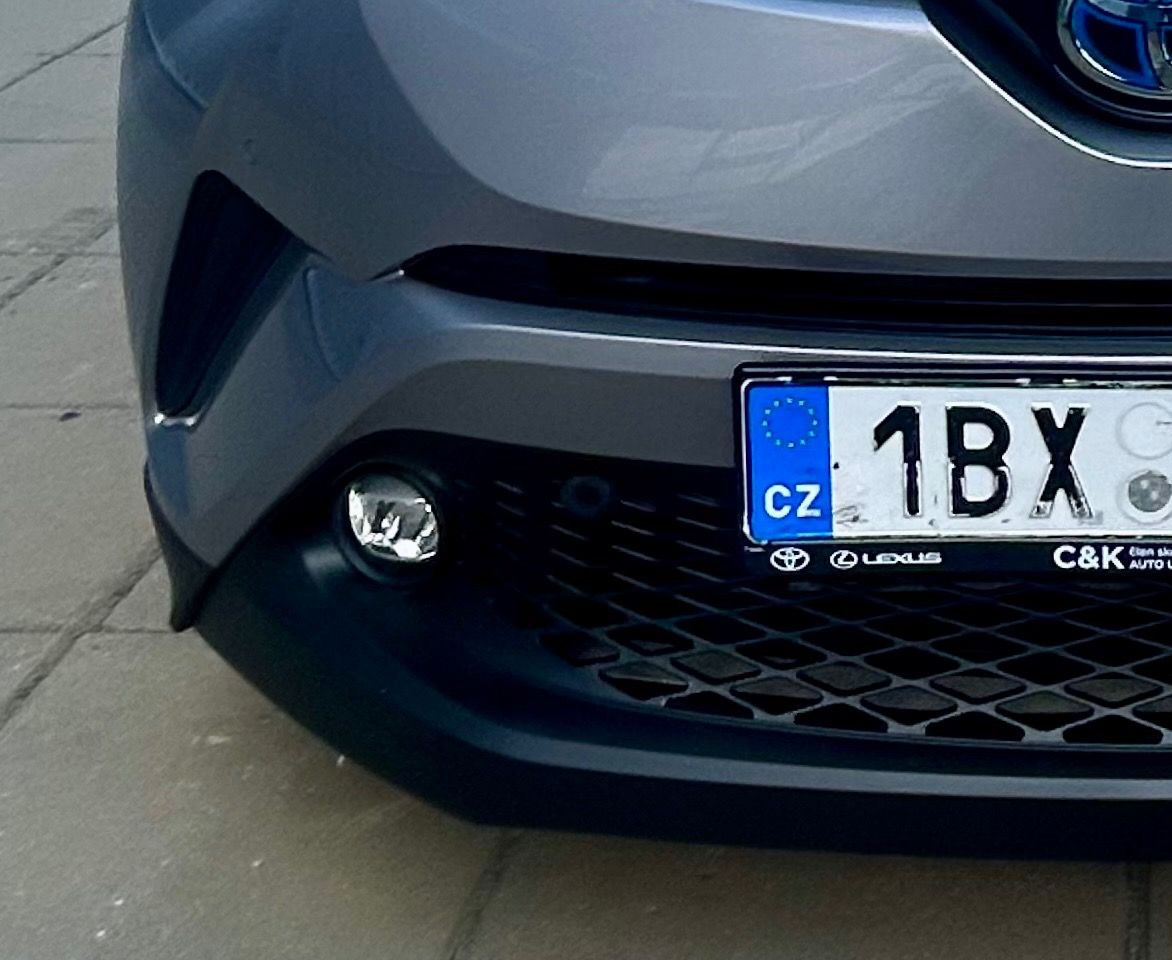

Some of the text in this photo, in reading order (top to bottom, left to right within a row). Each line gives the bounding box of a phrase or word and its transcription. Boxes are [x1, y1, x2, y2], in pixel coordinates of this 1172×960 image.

[873, 401, 1094, 518] 1BX
[764, 484, 822, 519] CZ
[862, 551, 943, 565] LEXUS
[1053, 544, 1126, 570] C&K
[1129, 559, 1165, 571] AUTO
